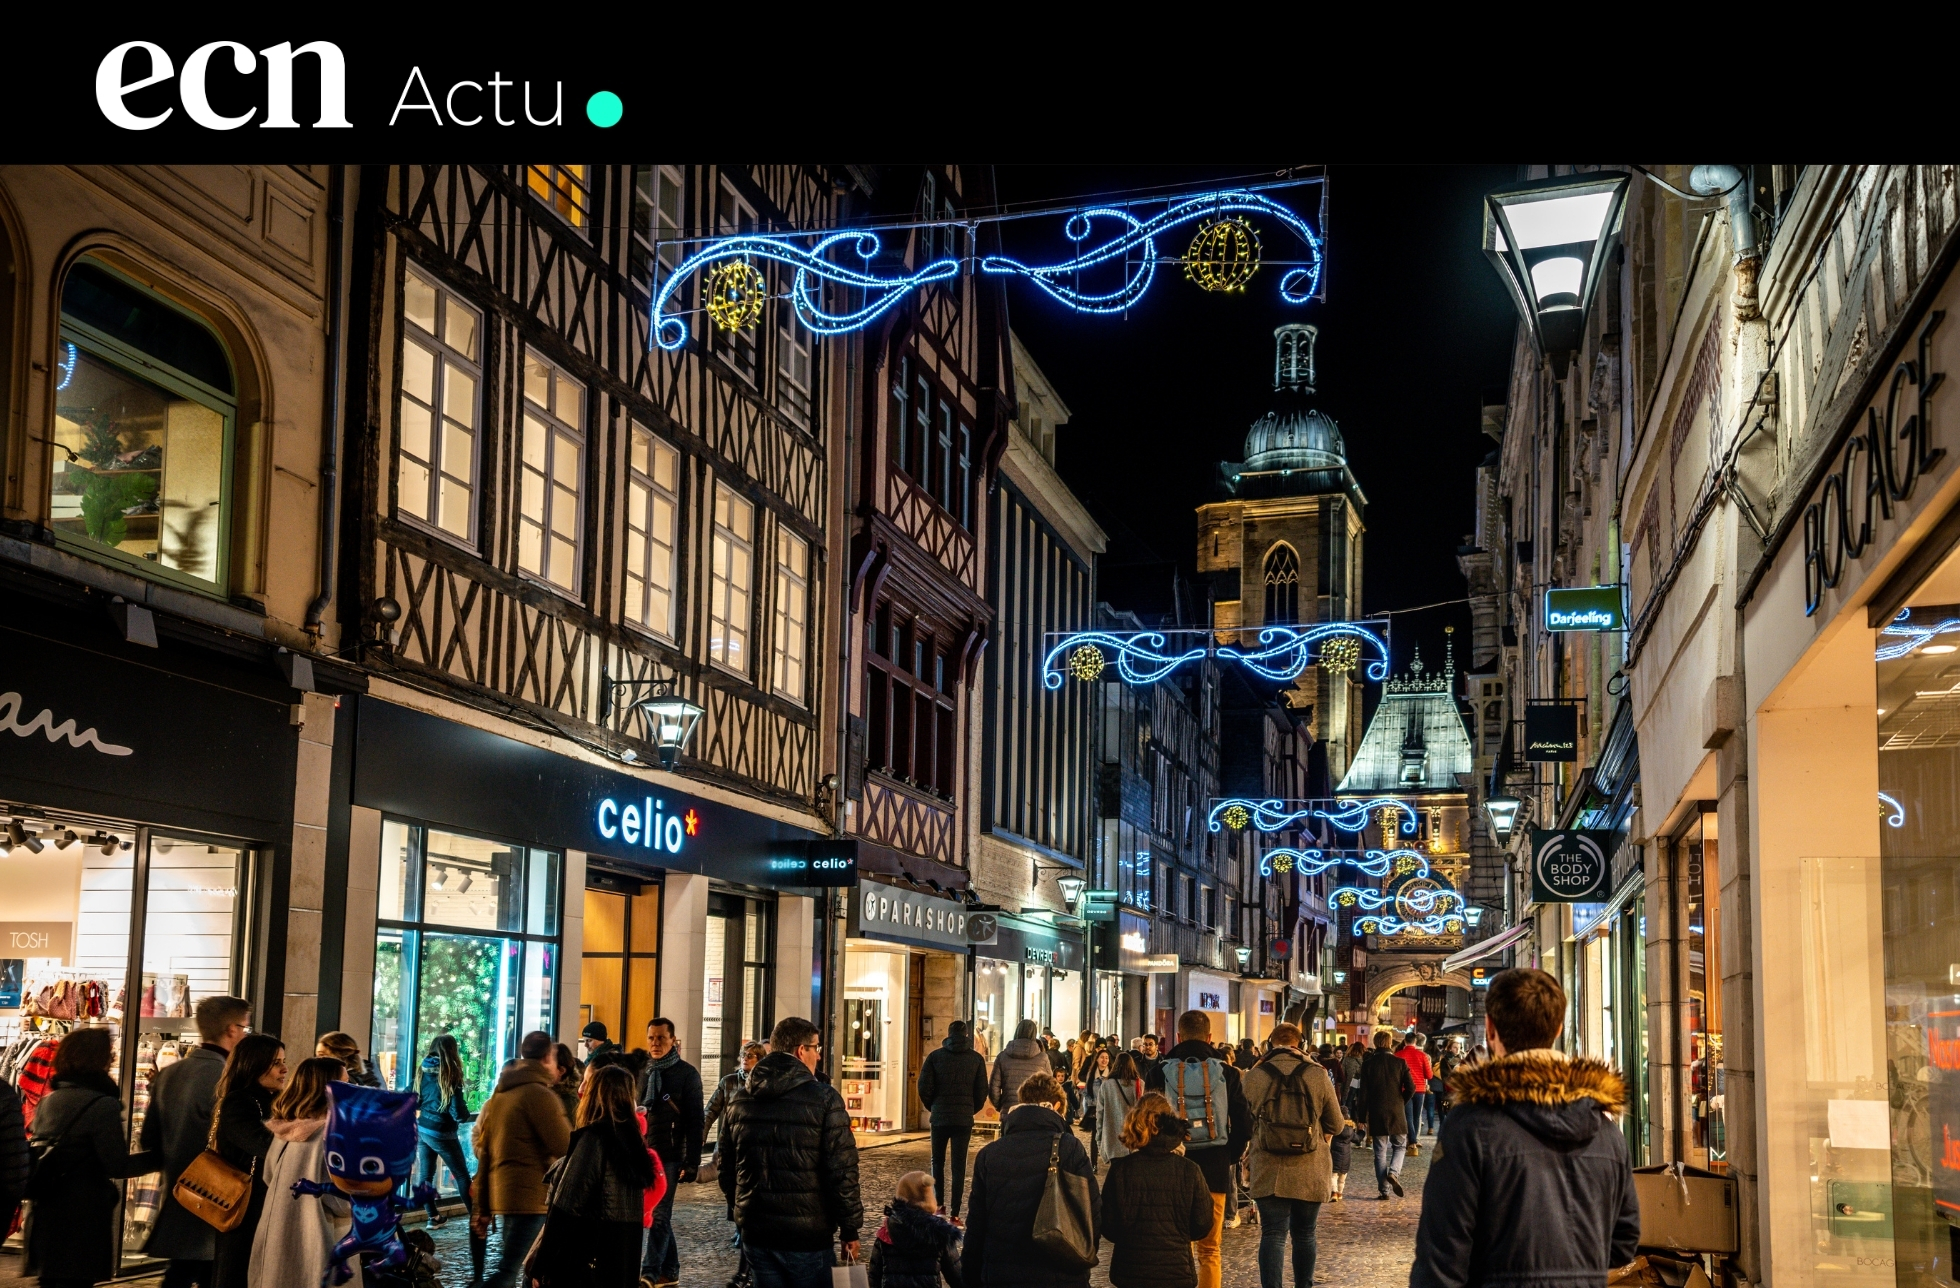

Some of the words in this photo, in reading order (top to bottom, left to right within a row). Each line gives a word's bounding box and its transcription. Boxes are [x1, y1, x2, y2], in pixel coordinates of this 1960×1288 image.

[1805, 309, 1946, 617] BOCAGE
[1550, 611, 1612, 626] Darjeeling
[1559, 853, 1583, 863] THE
[1551, 863, 1592, 875] BODY
[1553, 875, 1591, 886] SHOP
[879, 896, 965, 935] PARASHOP
[9, 932, 49, 949] TOSH
